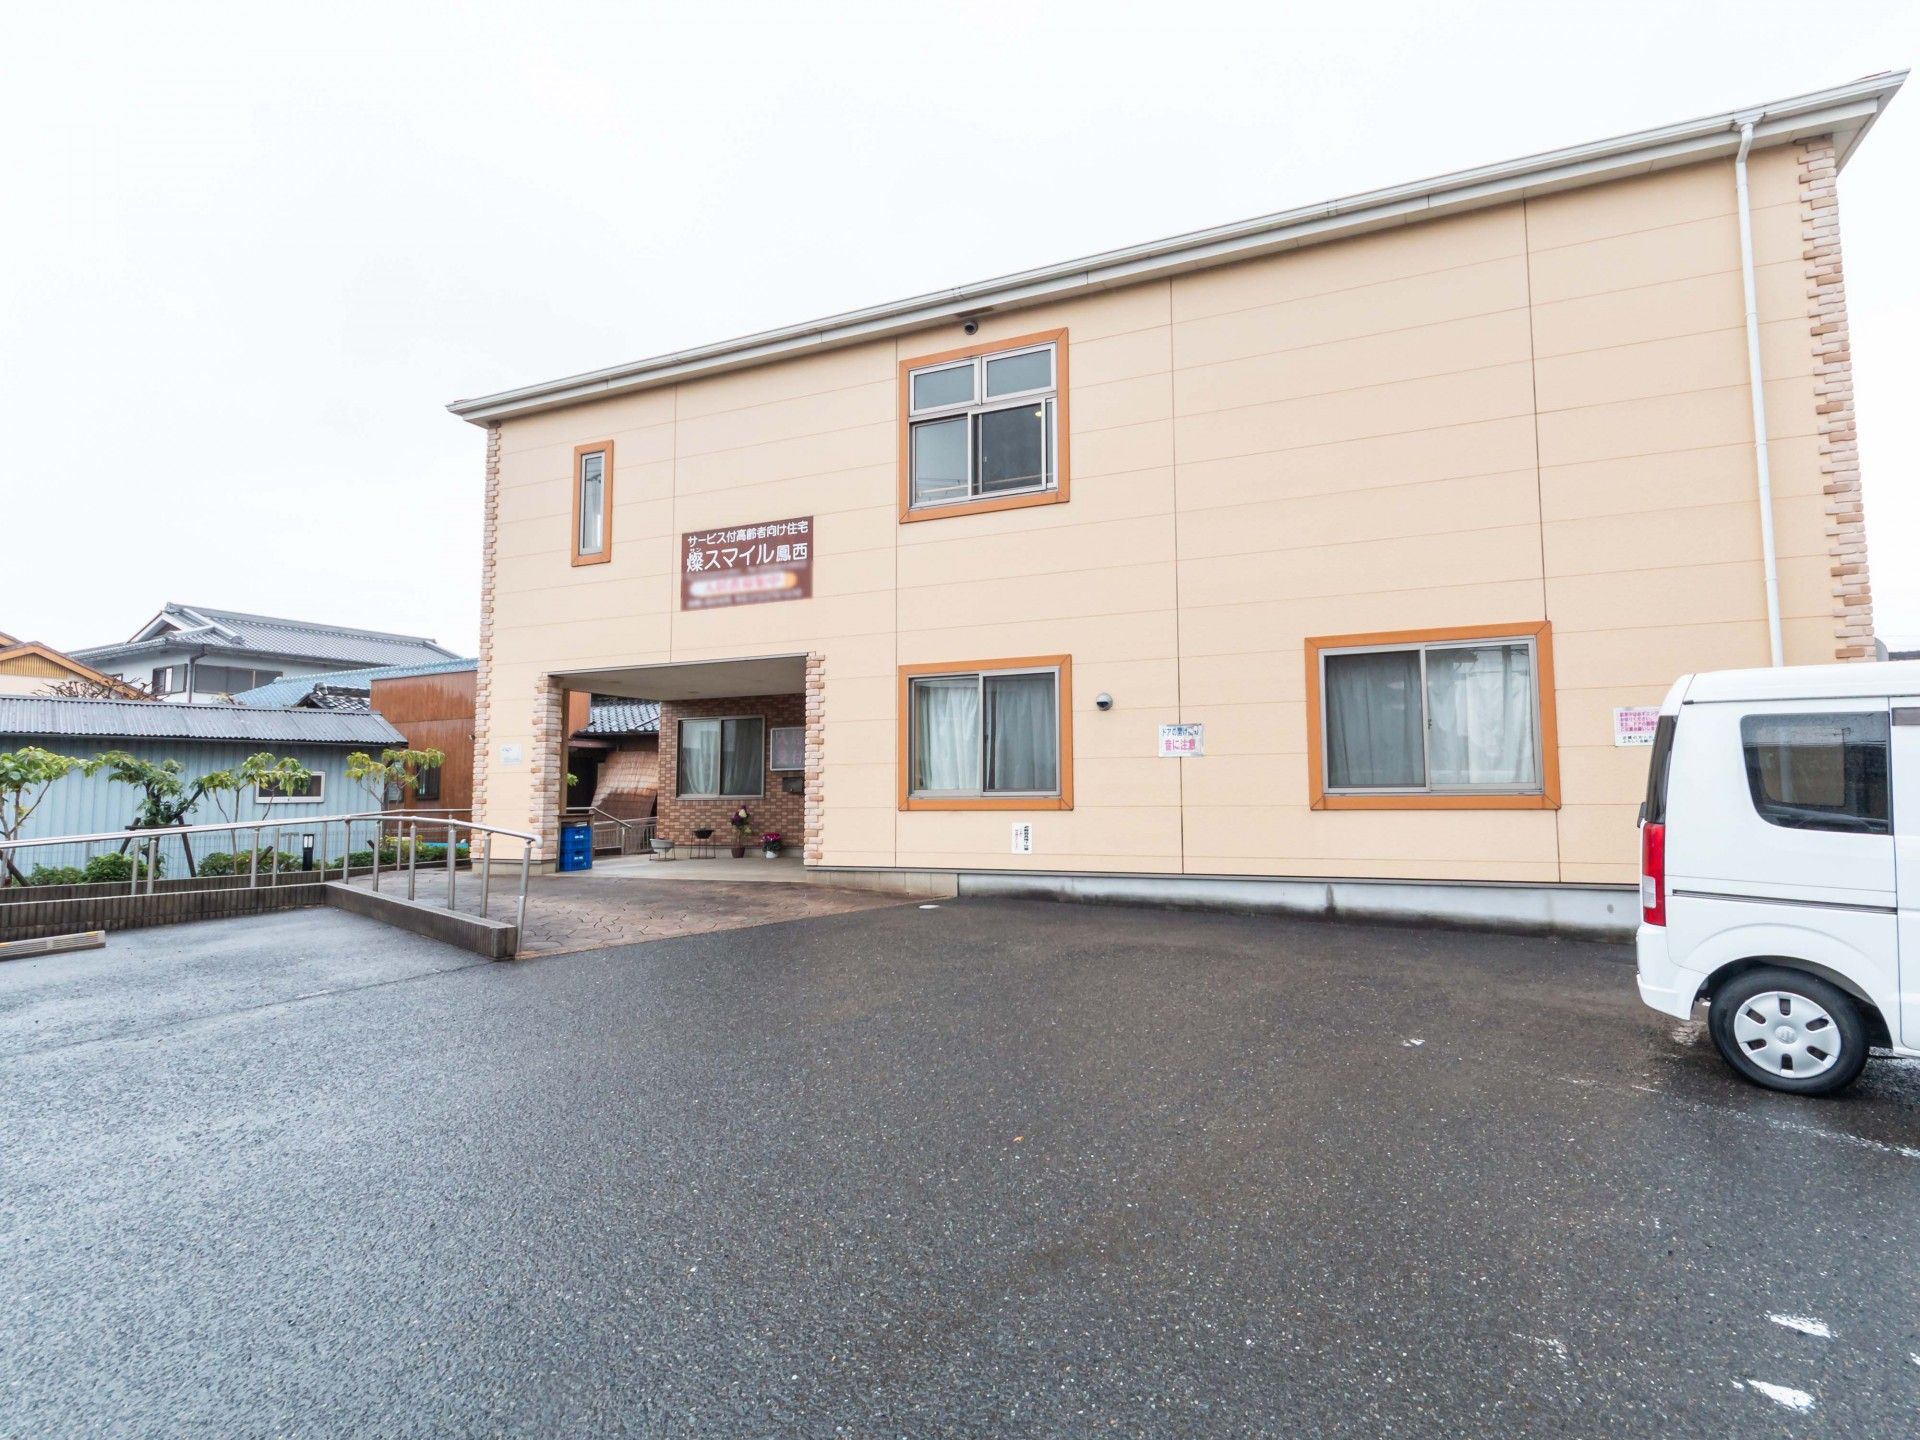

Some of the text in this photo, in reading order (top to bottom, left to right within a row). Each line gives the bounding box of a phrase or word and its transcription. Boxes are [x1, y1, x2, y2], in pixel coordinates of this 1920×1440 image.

[688, 521, 808, 547] サービス付高齢者向け住宅
[1164, 739, 1196, 751] 音に注意
